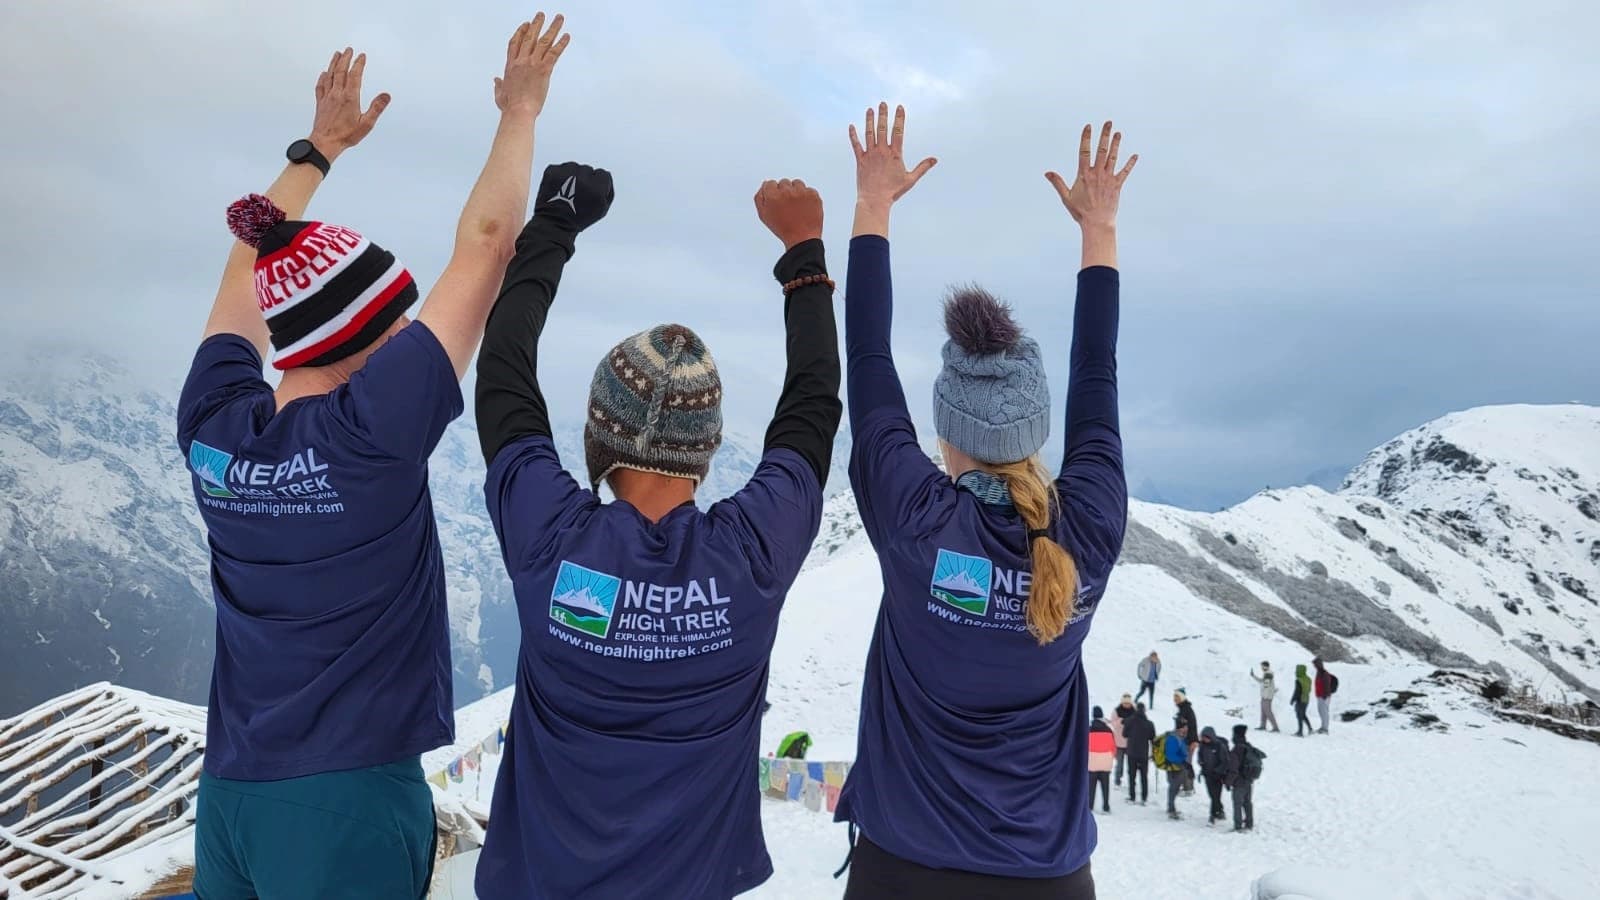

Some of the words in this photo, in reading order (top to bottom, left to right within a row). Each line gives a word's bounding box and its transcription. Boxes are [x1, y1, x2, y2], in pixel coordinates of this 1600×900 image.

[230, 448, 329, 485] NEPAL
[277, 474, 332, 497] TREK
[202, 498, 344, 517] www.nepalhightrek.com
[623, 577, 731, 613] NEPAL
[617, 613, 666, 633] HIGH
[671, 608, 730, 632] TREK
[549, 624, 733, 662] www.nepalhightrek.com
[615, 632, 658, 643] EXPLORE
[661, 634, 679, 643] THE
[681, 627, 732, 643] HIMALAYAS
